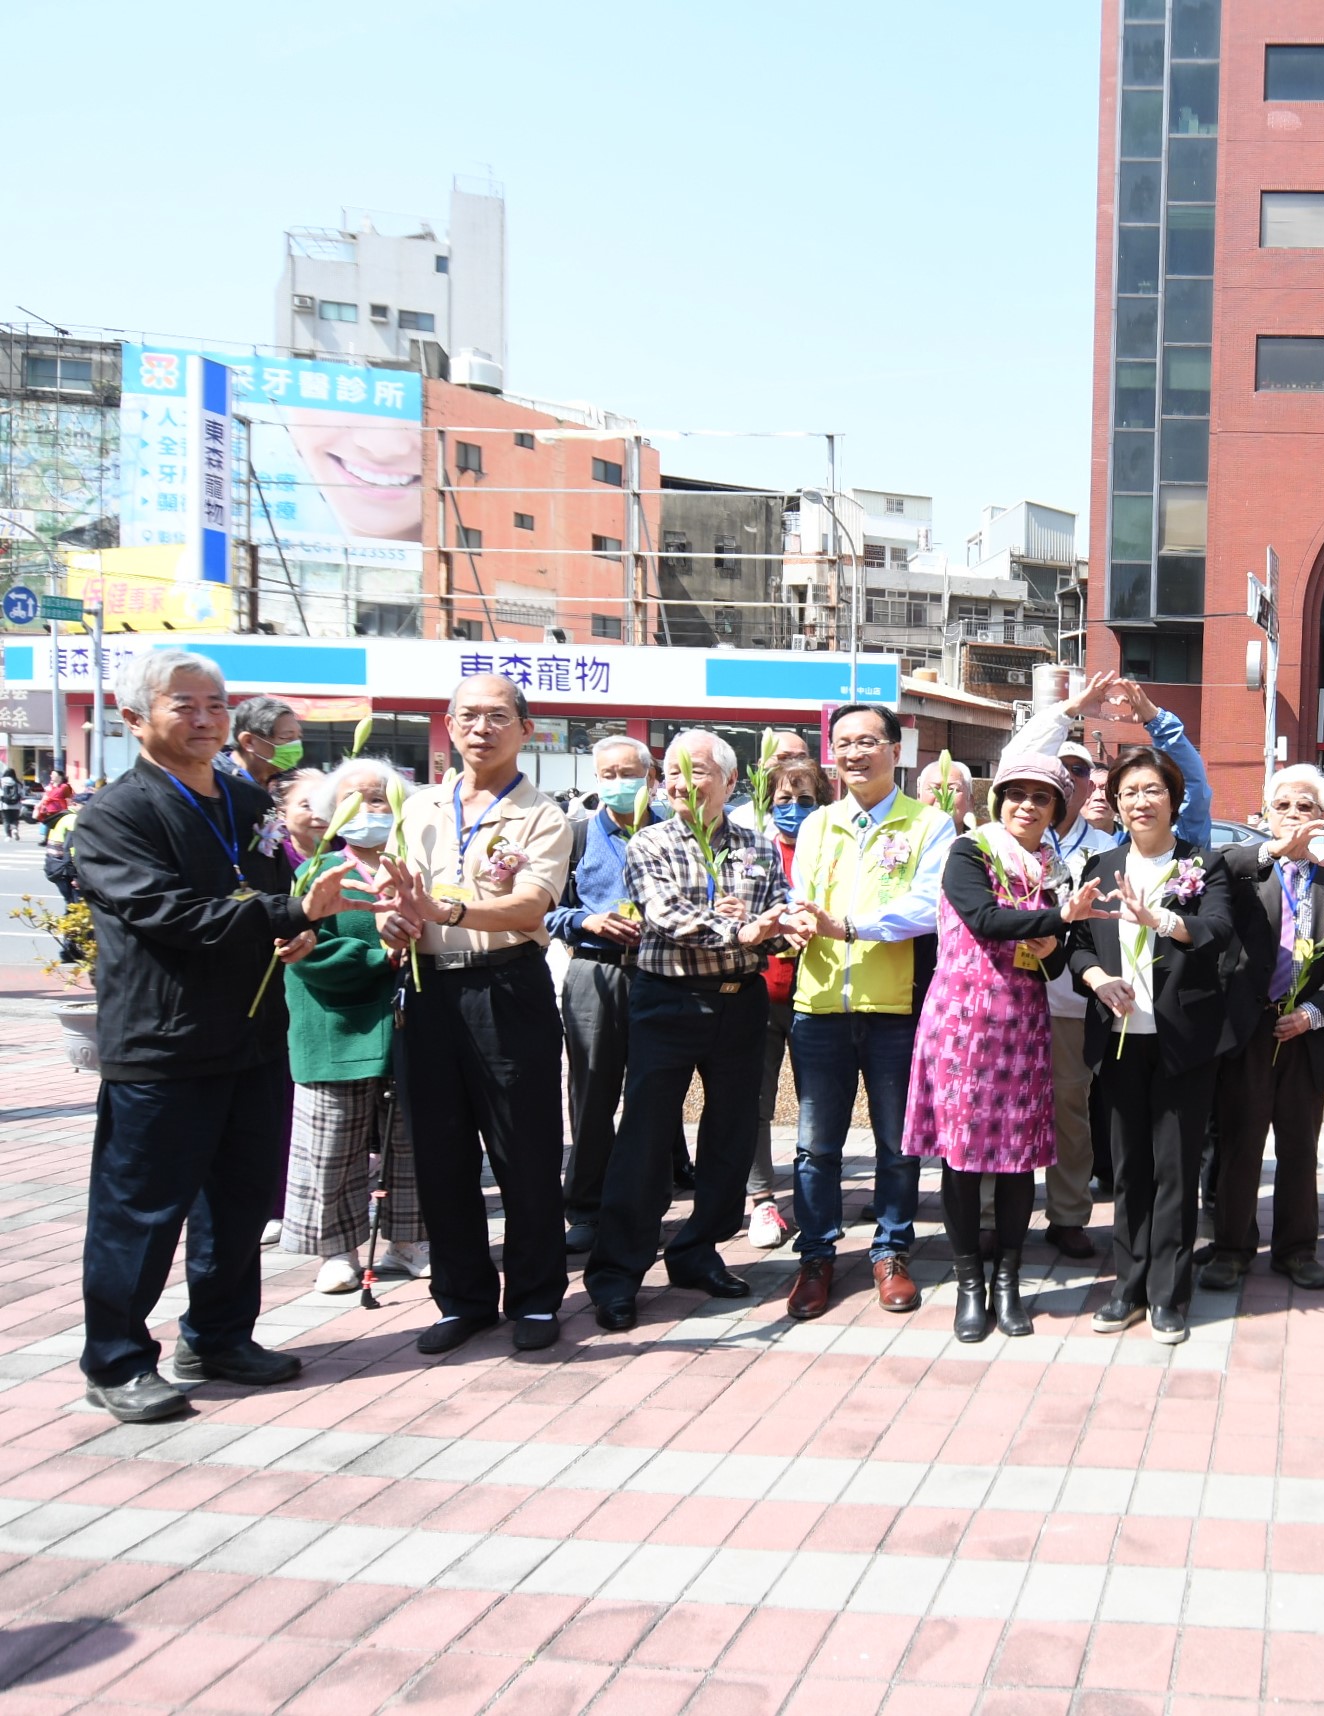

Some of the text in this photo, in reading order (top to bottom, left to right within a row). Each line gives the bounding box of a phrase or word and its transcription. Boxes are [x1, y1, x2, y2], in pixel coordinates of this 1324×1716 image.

[204, 418, 224, 527] 東森寵物
[460, 652, 610, 693] 東森寵物
